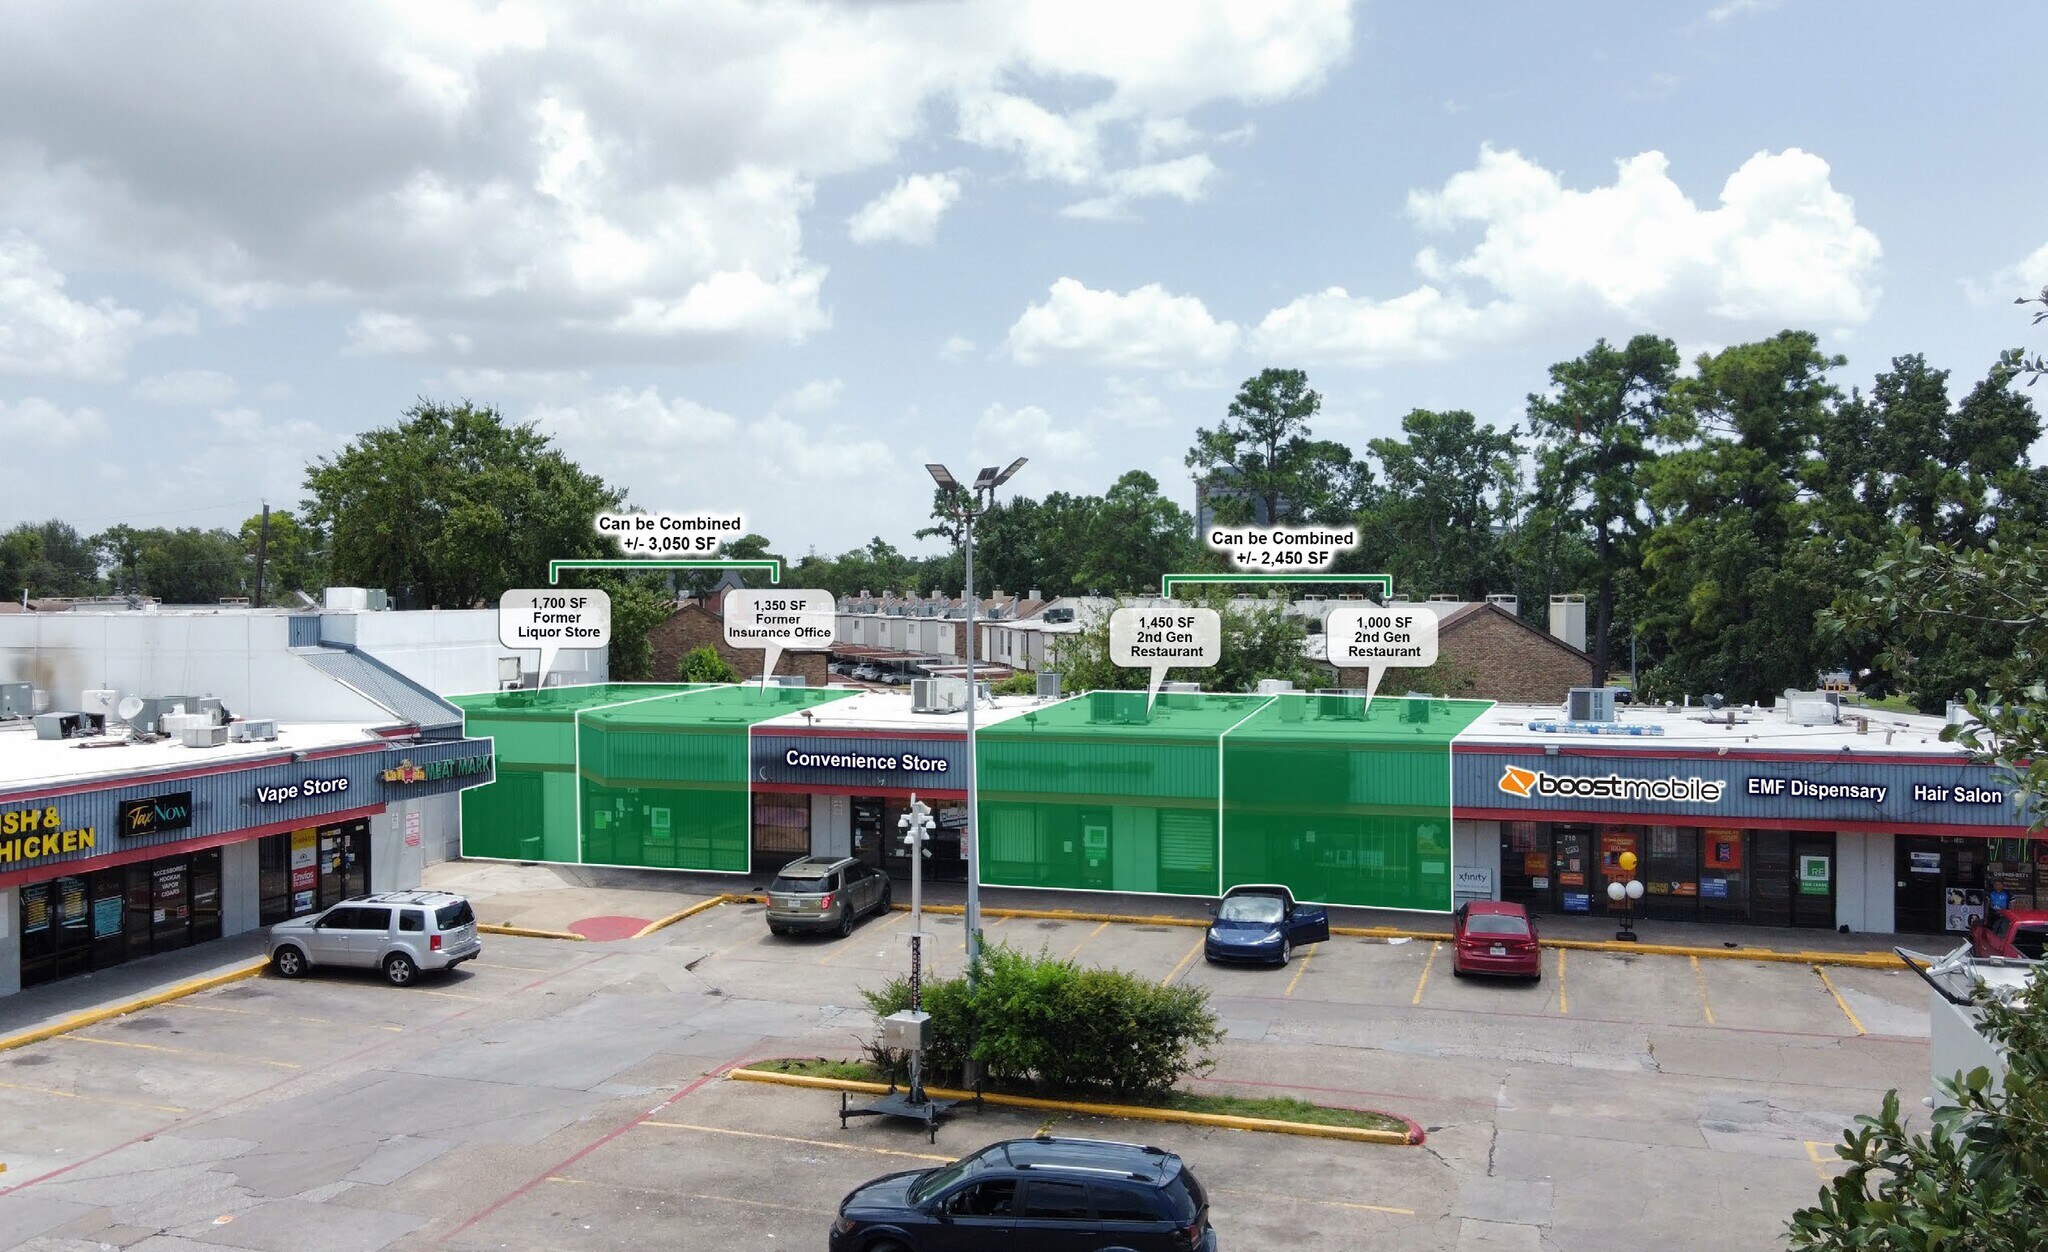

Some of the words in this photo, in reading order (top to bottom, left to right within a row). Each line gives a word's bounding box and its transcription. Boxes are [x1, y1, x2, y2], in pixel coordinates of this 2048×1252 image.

[426, 759, 455, 781] MEAT
[458, 754, 492, 776] MARK
[0, 808, 38, 835] SH
[43, 805, 61, 828] &
[128, 806, 154, 829] Tax
[154, 803, 189, 821] Now
[1459, 872, 1487, 883] xfinity
[1811, 867, 1825, 876] RE
[162, 881, 179, 889] VAPOR
